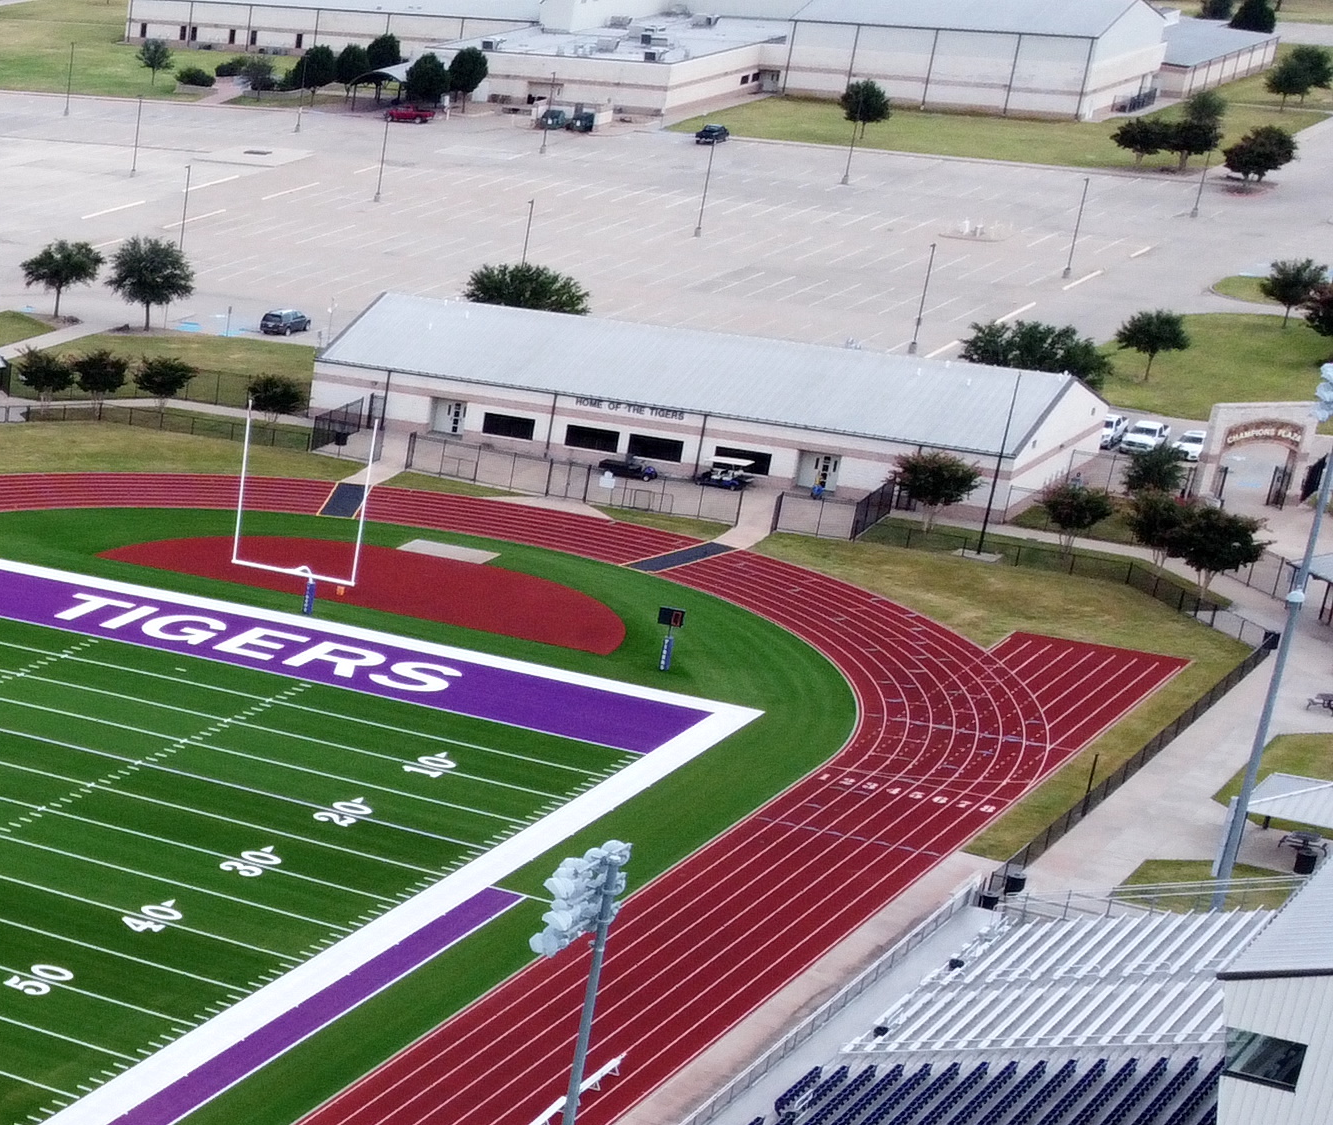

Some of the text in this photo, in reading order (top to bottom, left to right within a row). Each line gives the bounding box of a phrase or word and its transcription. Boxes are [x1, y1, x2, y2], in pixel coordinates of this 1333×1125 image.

[575, 397, 685, 421] HOME OF THE TIGERS
[1226, 428, 1302, 444] CHAMPIONS PLAZA
[54, 592, 462, 693] TIGERS
[402, 755, 456, 778] 10
[818, 773, 996, 813] 1 2 3 4 5 6 7 8
[313, 800, 373, 827] 20
[219, 850, 282, 877] 30
[122, 904, 182, 932] 40
[3, 964, 74, 996] 50
